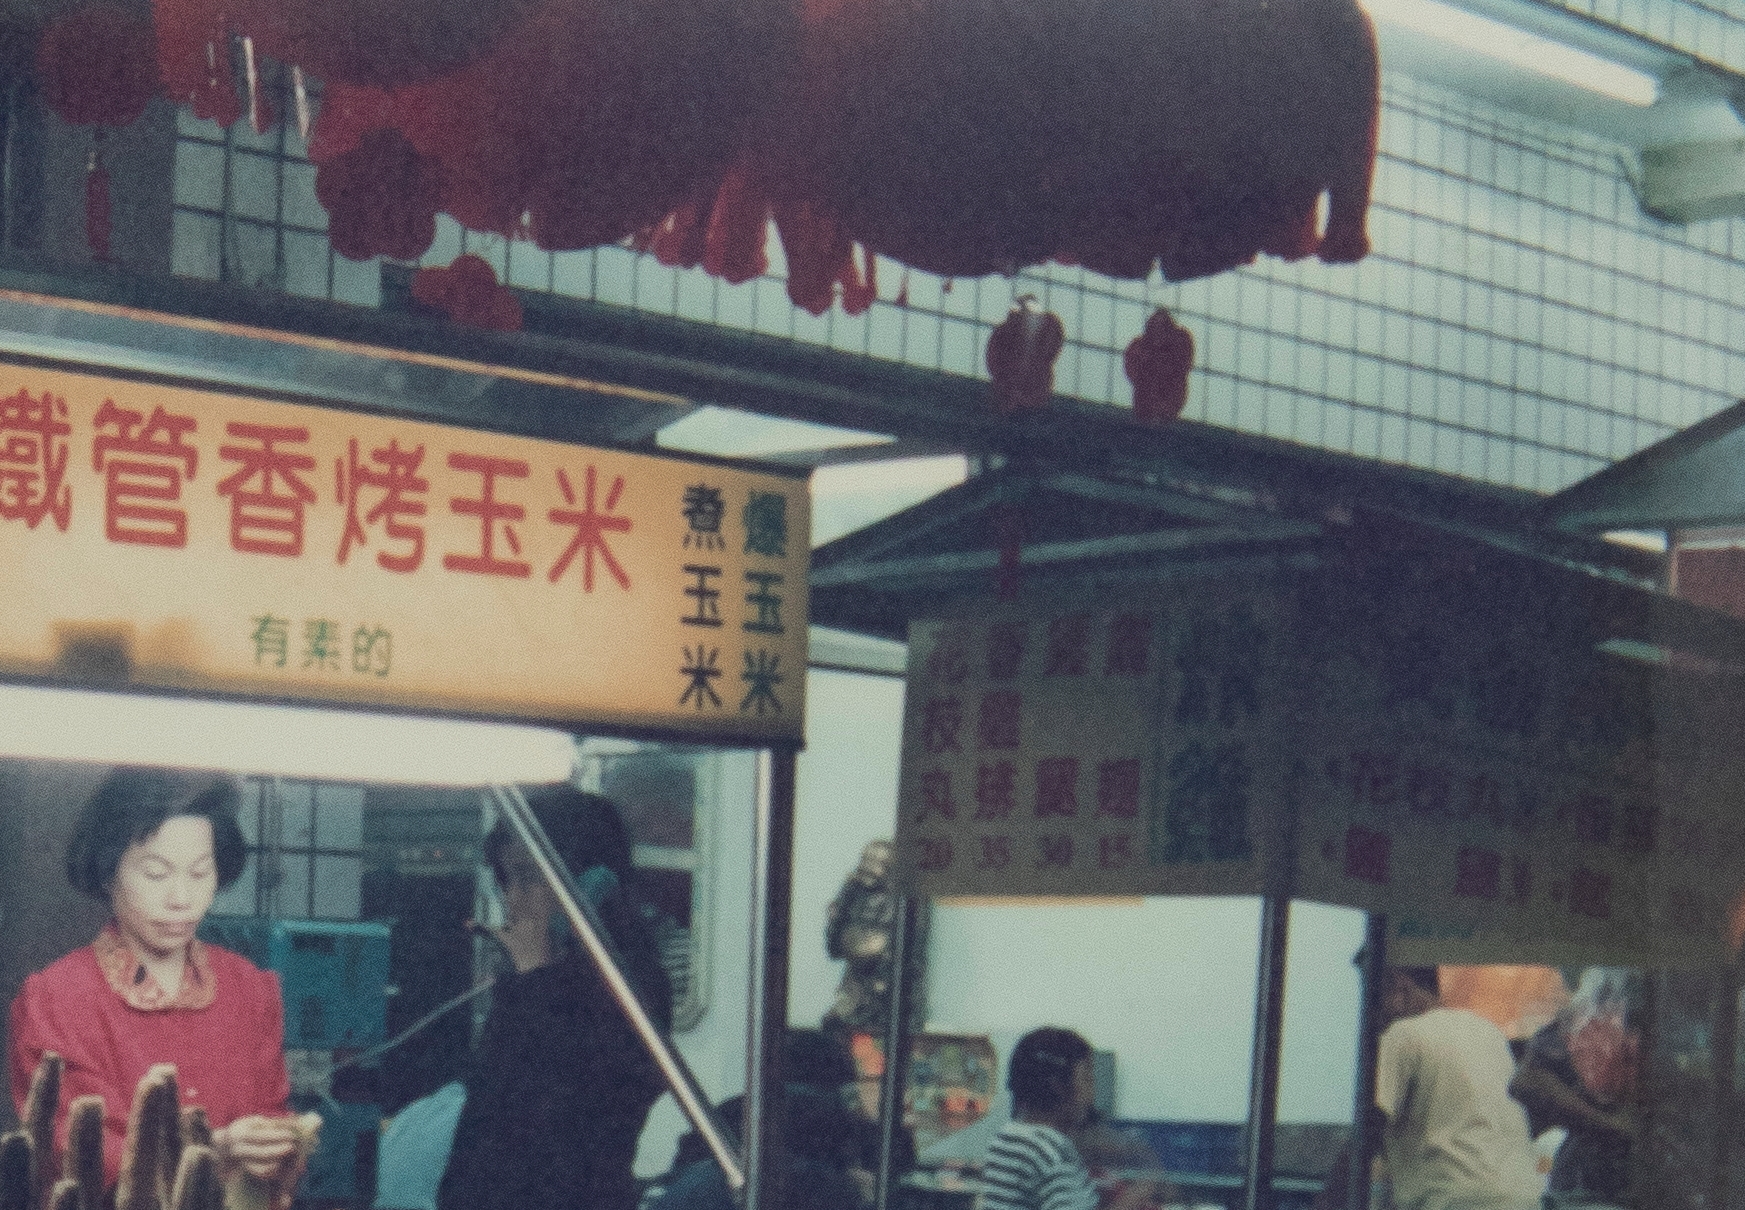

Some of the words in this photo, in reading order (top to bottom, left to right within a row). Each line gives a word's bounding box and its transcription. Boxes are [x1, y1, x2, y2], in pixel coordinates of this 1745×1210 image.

[249, 613, 394, 679] 有素的
[679, 483, 726, 710] 煮玉米
